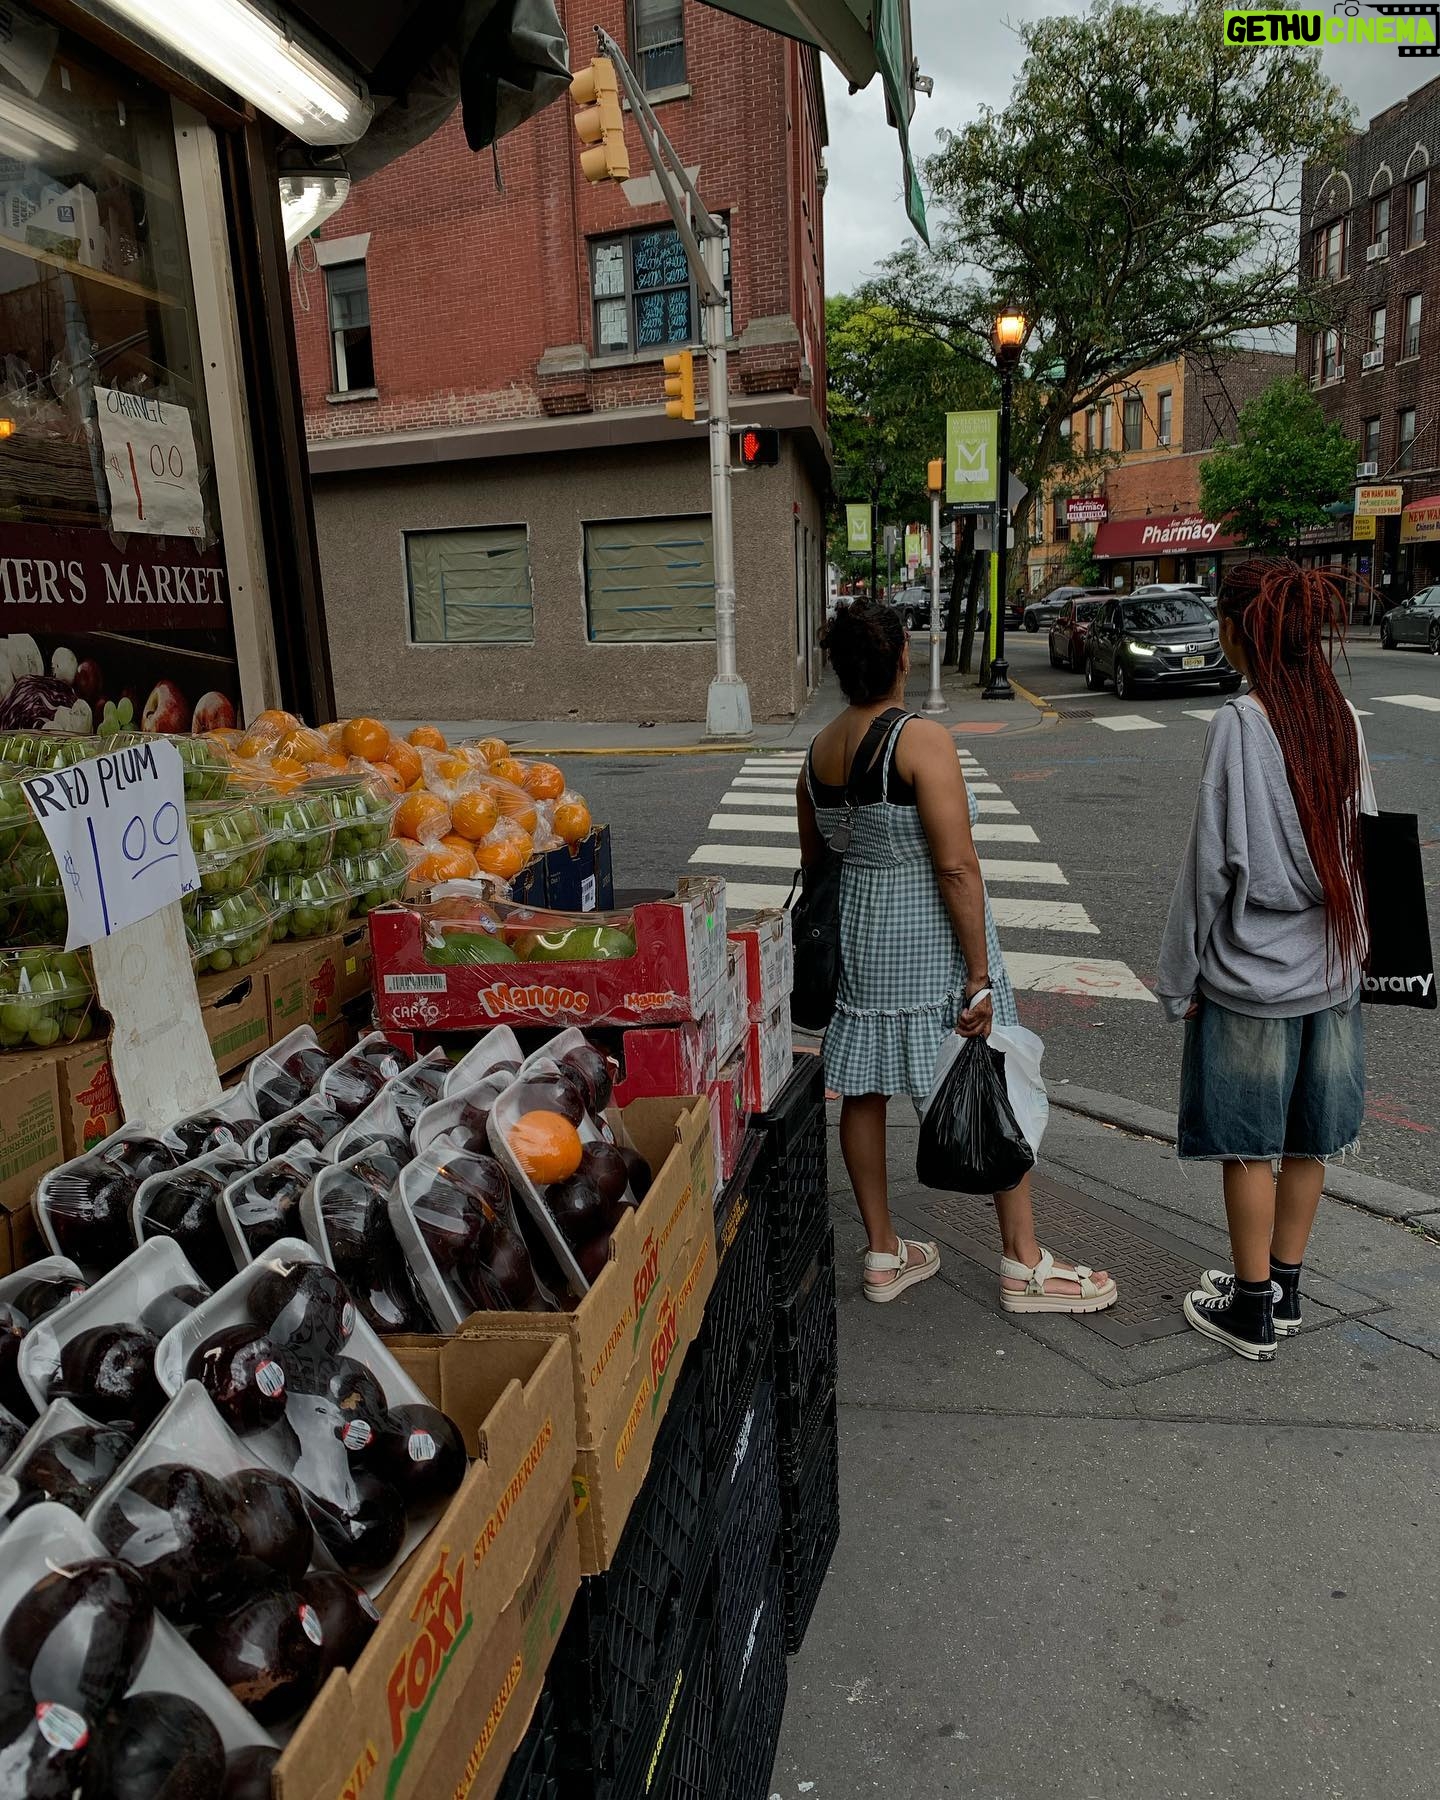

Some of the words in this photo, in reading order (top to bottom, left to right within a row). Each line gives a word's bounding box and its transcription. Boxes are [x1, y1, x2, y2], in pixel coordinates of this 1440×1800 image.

[106, 390, 168, 425] ORANGE
[1069, 504, 1104, 512] Pharmacy
[1408, 512, 1425, 522] NEW
[1142, 522, 1221, 544] Pharmacy
[1416, 522, 1434, 532] Chinese
[101, 562, 224, 604] MARKET
[23, 767, 89, 817] RED
[97, 744, 158, 807] PLUM
[393, 1005, 439, 1018] CAPCO
[479, 982, 590, 1017] Mangos
[590, 1305, 633, 1387] CALIFORNIA
[632, 1236, 660, 1320] FOXY
[615, 1374, 650, 1471] CALIFORNIA
[650, 1299, 678, 1391] FOXY
[387, 1554, 466, 1754] FOXY
[473, 1416, 552, 1570] STRAWBERRIES
